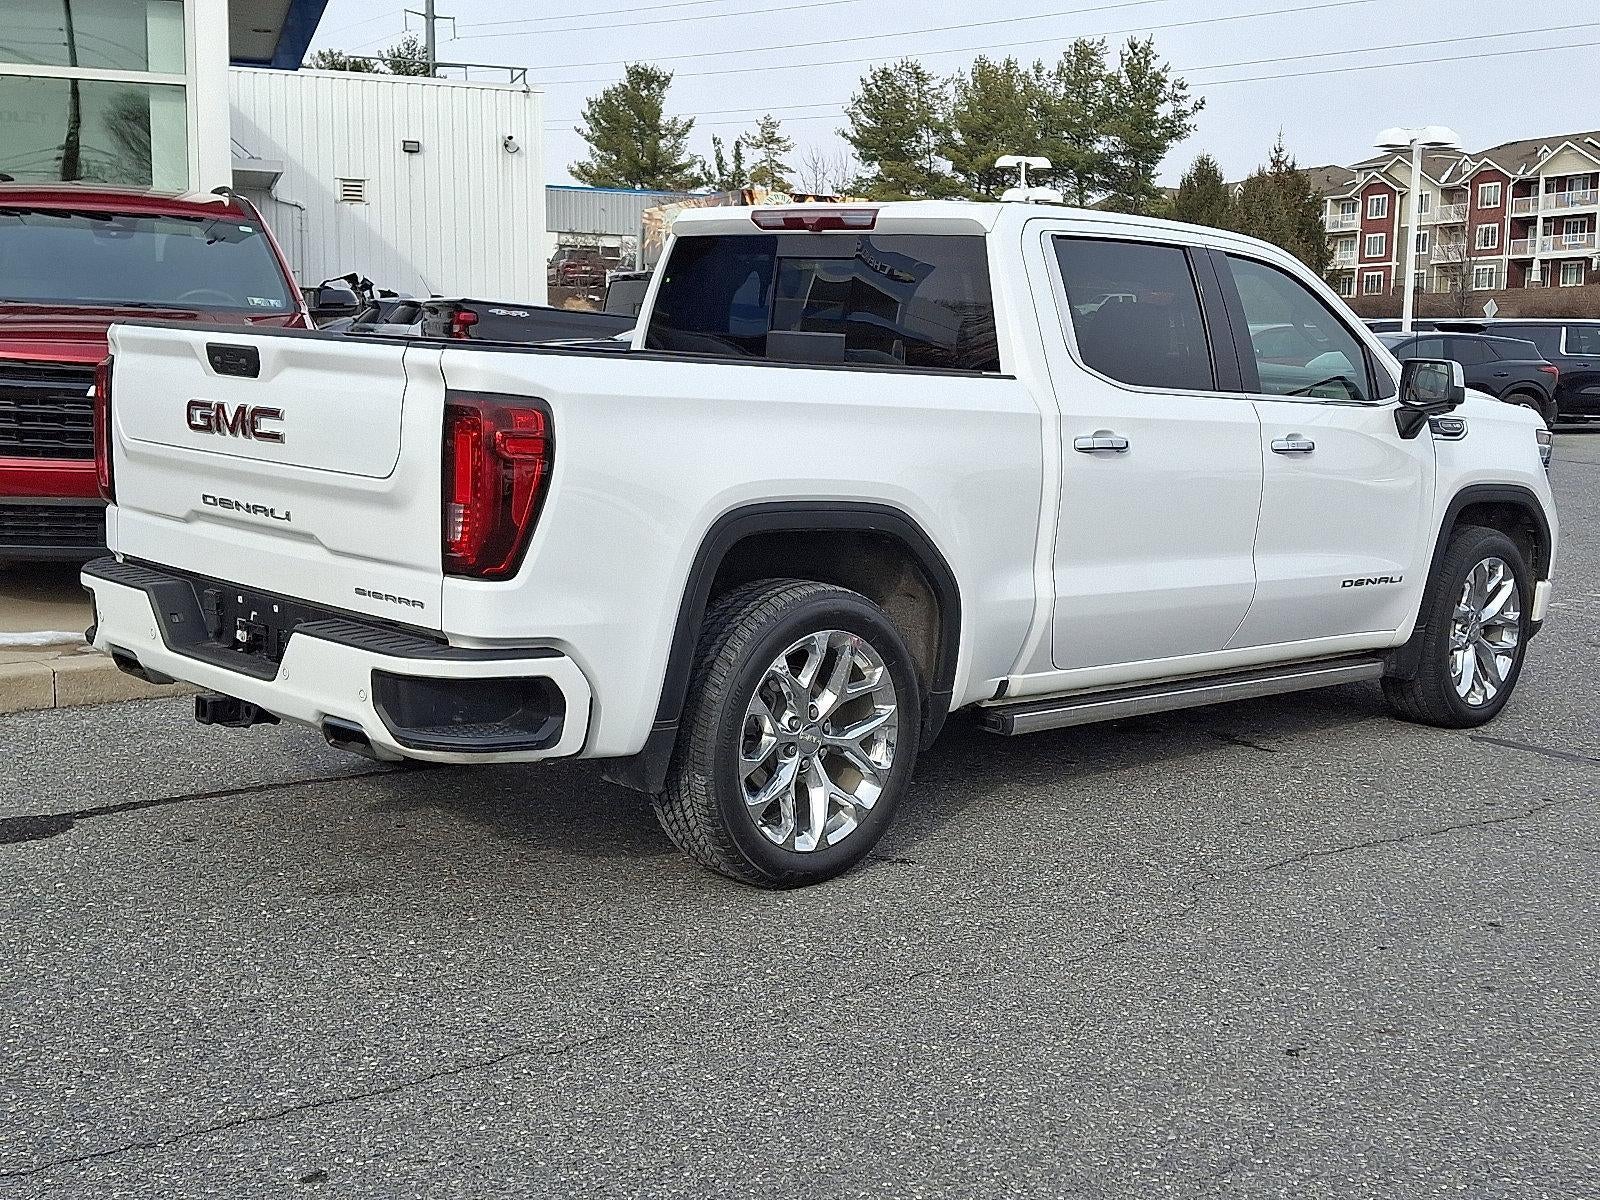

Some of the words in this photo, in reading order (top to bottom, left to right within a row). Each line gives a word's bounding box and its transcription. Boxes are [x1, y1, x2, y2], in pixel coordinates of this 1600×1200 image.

[186, 399, 286, 443] GMC
[202, 494, 291, 522] DENALI
[1341, 575, 1404, 589] DENALI
[355, 586, 425, 610] SIERRA
